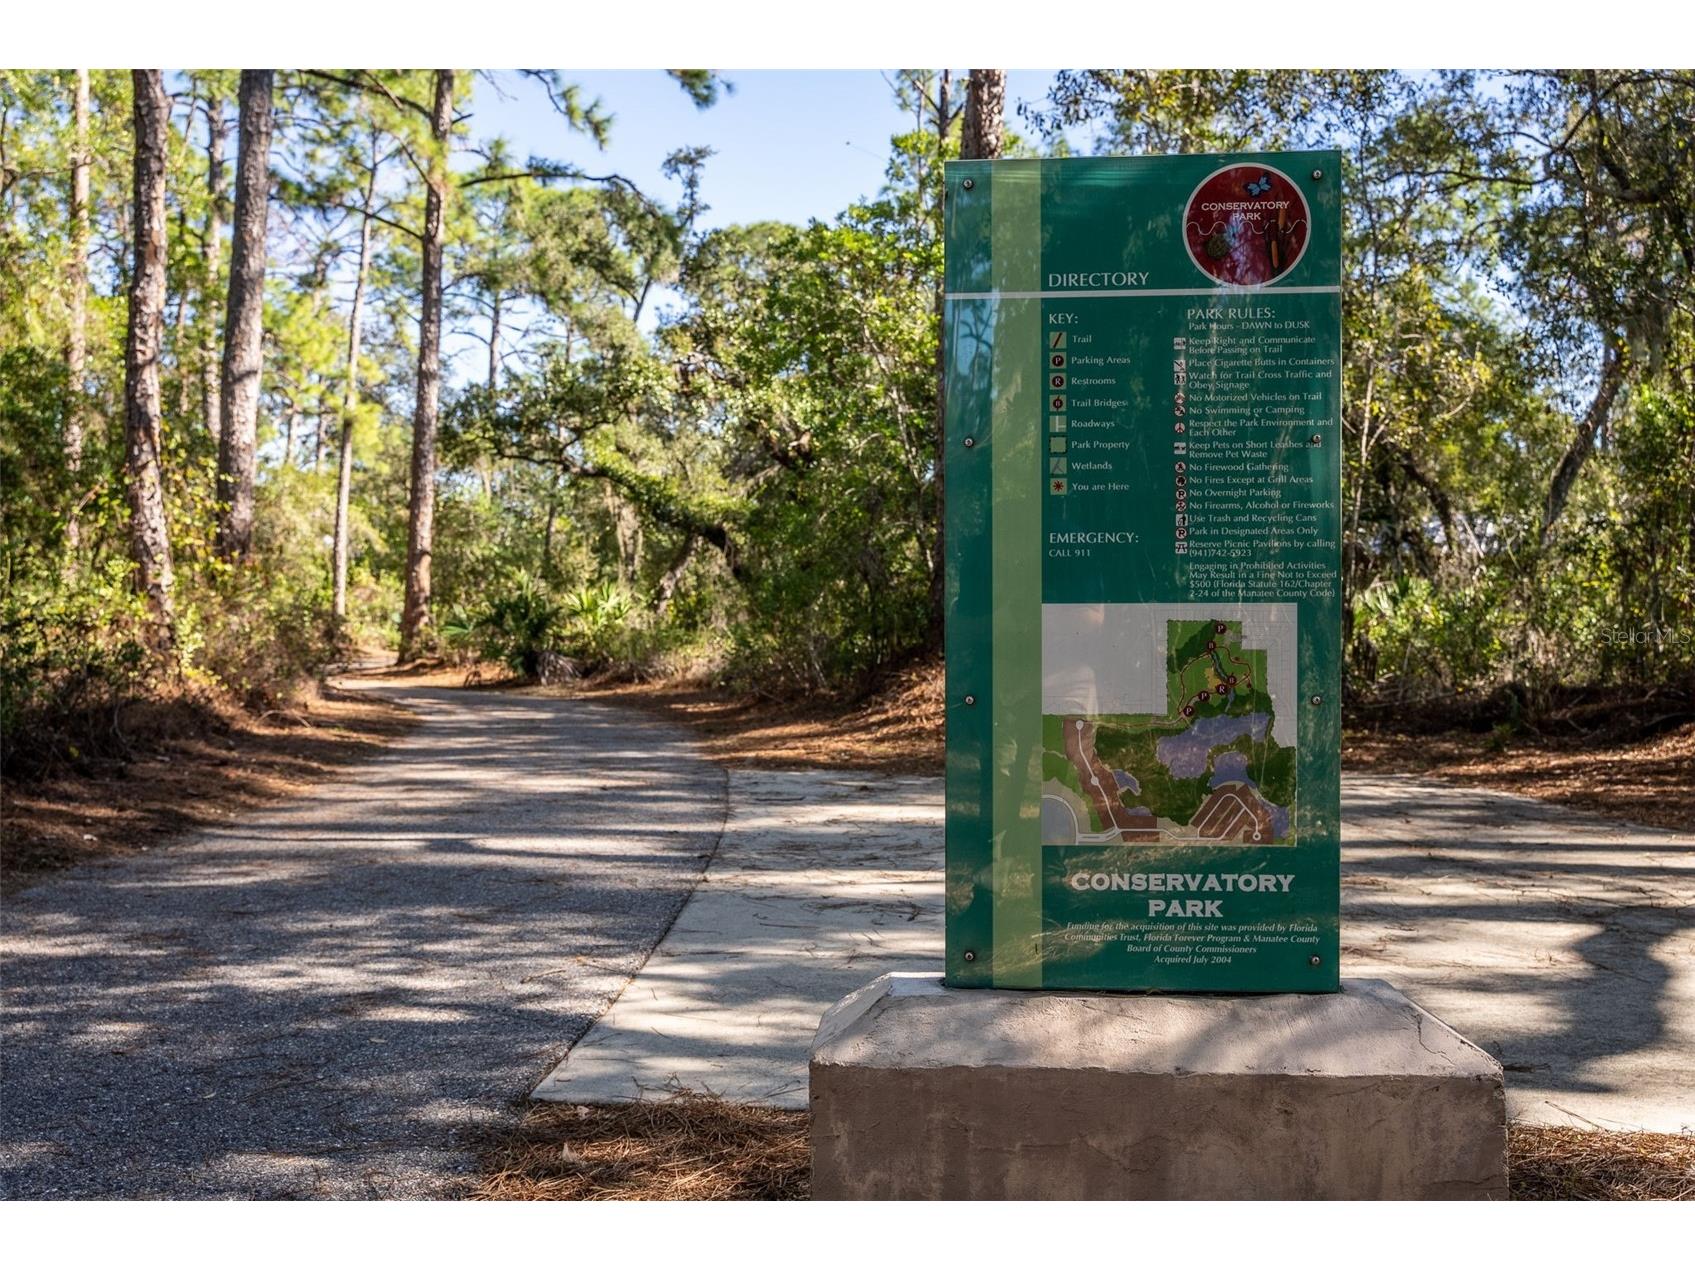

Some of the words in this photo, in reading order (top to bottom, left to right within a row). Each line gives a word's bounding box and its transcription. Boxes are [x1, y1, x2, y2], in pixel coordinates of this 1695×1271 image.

[1202, 201, 1290, 211] CONSERVATORY
[1049, 272, 1149, 287] DIRECTORY
[1187, 309, 1223, 319] PARK
[1228, 307, 1276, 319] RULES:
[1049, 313, 1078, 324] KEY:
[1189, 338, 1210, 346] Keep
[1217, 346, 1247, 355] Passing
[1071, 356, 1104, 366] Parking
[1214, 359, 1252, 368] Cigarette
[1189, 382, 1212, 390] Obey
[1216, 382, 1250, 390] Signage
[1094, 400, 1126, 408] Bridges
[1205, 407, 1250, 416] Swimming
[1266, 406, 1304, 415] Camping
[1072, 420, 1115, 428] Roadways
[1189, 420, 1222, 428] Respect
[1093, 441, 1130, 450] Property
[1189, 441, 1210, 450] Keep
[1247, 464, 1288, 472] Gathering
[1205, 489, 1247, 498] Overnight
[1250, 489, 1281, 498] Parking
[1252, 514, 1294, 523] Recycling
[1221, 527, 1268, 536] Designated
[1297, 527, 1318, 536] Only
[1050, 532, 1139, 543] EMERGENCY:
[1294, 540, 1304, 548] by
[1307, 540, 1335, 548] calling
[1189, 562, 1227, 571] Engaging
[1189, 571, 1207, 580] May
[1276, 589, 1306, 598] County
[1309, 589, 1335, 597] Code)
[1071, 873, 1295, 891] CONSERVATORY
[1148, 899, 1224, 918] PARK
[1130, 922, 1175, 932] acquisition
[1177, 922, 1186, 931] of
[1204, 923, 1218, 931] site
[1239, 923, 1275, 933] provided
[1277, 923, 1286, 933] by
[1289, 923, 1317, 932] Florida
[1120, 933, 1141, 942] Trust,
[1144, 933, 1172, 942] Florida
[1174, 934, 1205, 942] Forever
[1207, 934, 1241, 944] Program
[1253, 935, 1288, 943] Manatee
[1290, 935, 1320, 945] County
[1153, 945, 1162, 953] of
[1164, 945, 1193, 954] County
[1196, 945, 1256, 953] Commissioners
[1154, 956, 1191, 965] Acquired
[1193, 956, 1209, 965] July
[1211, 956, 1232, 964] 2004
